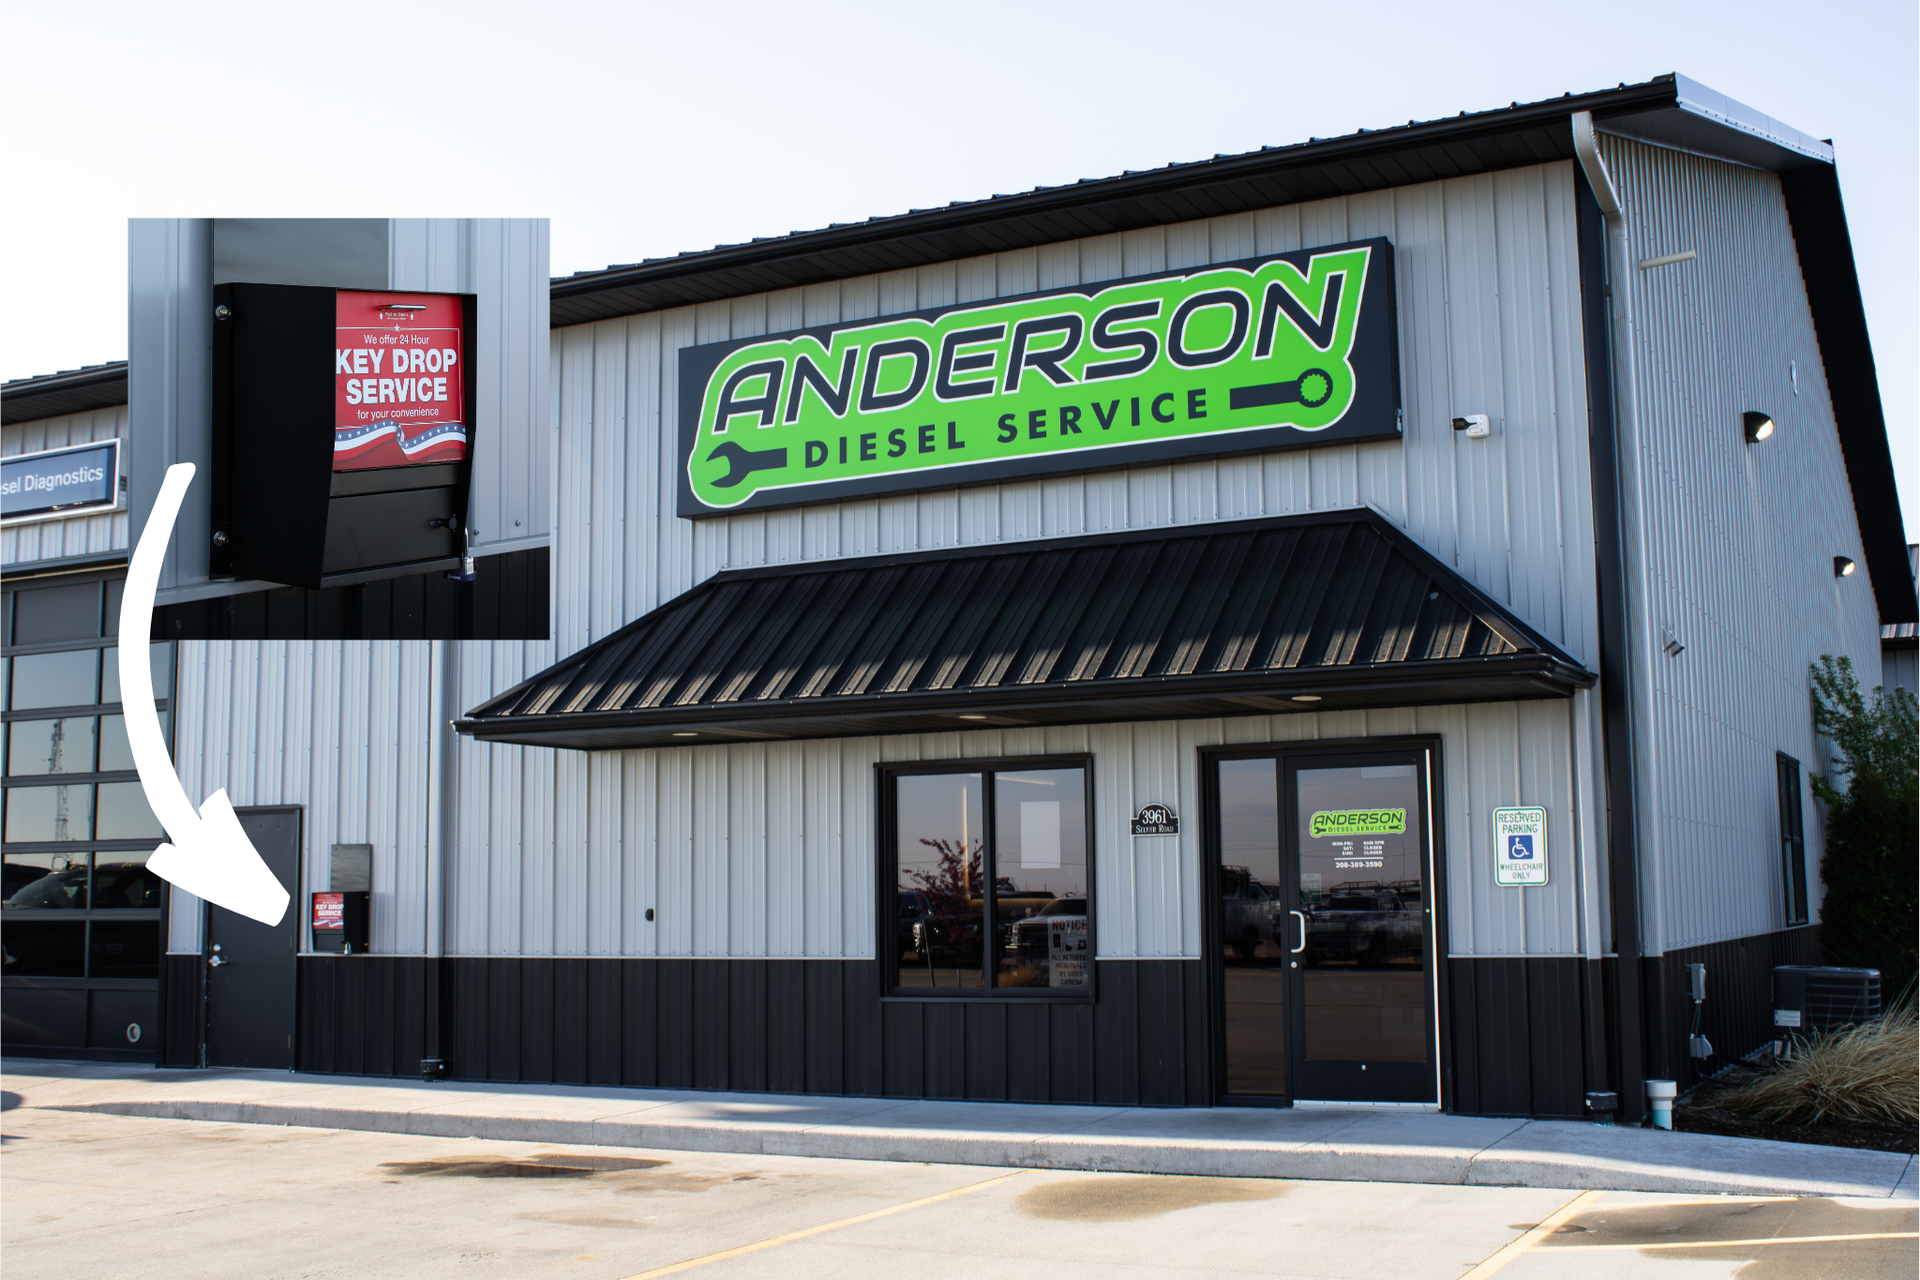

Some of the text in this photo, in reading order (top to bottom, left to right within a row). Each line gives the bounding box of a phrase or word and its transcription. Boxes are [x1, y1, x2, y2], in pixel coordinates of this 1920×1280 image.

[363, 335, 430, 345] We offer 24 Hour
[712, 270, 1346, 436] ANDERSON
[336, 348, 458, 375] KEY DROP
[346, 377, 448, 405] SERVICE
[357, 407, 440, 421] for your convenience
[803, 387, 1210, 470] DIESEL SERVICE
[0, 465, 104, 495] sel Diagnostics
[1142, 809, 1167, 824] 3961
[1313, 812, 1403, 826] ANDERSON
[1498, 812, 1541, 823] RESERVED
[1502, 824, 1538, 834] PARKING
[1500, 863, 1543, 871] WHEELCHAIR
[1052, 919, 1087, 931] NOTICE
